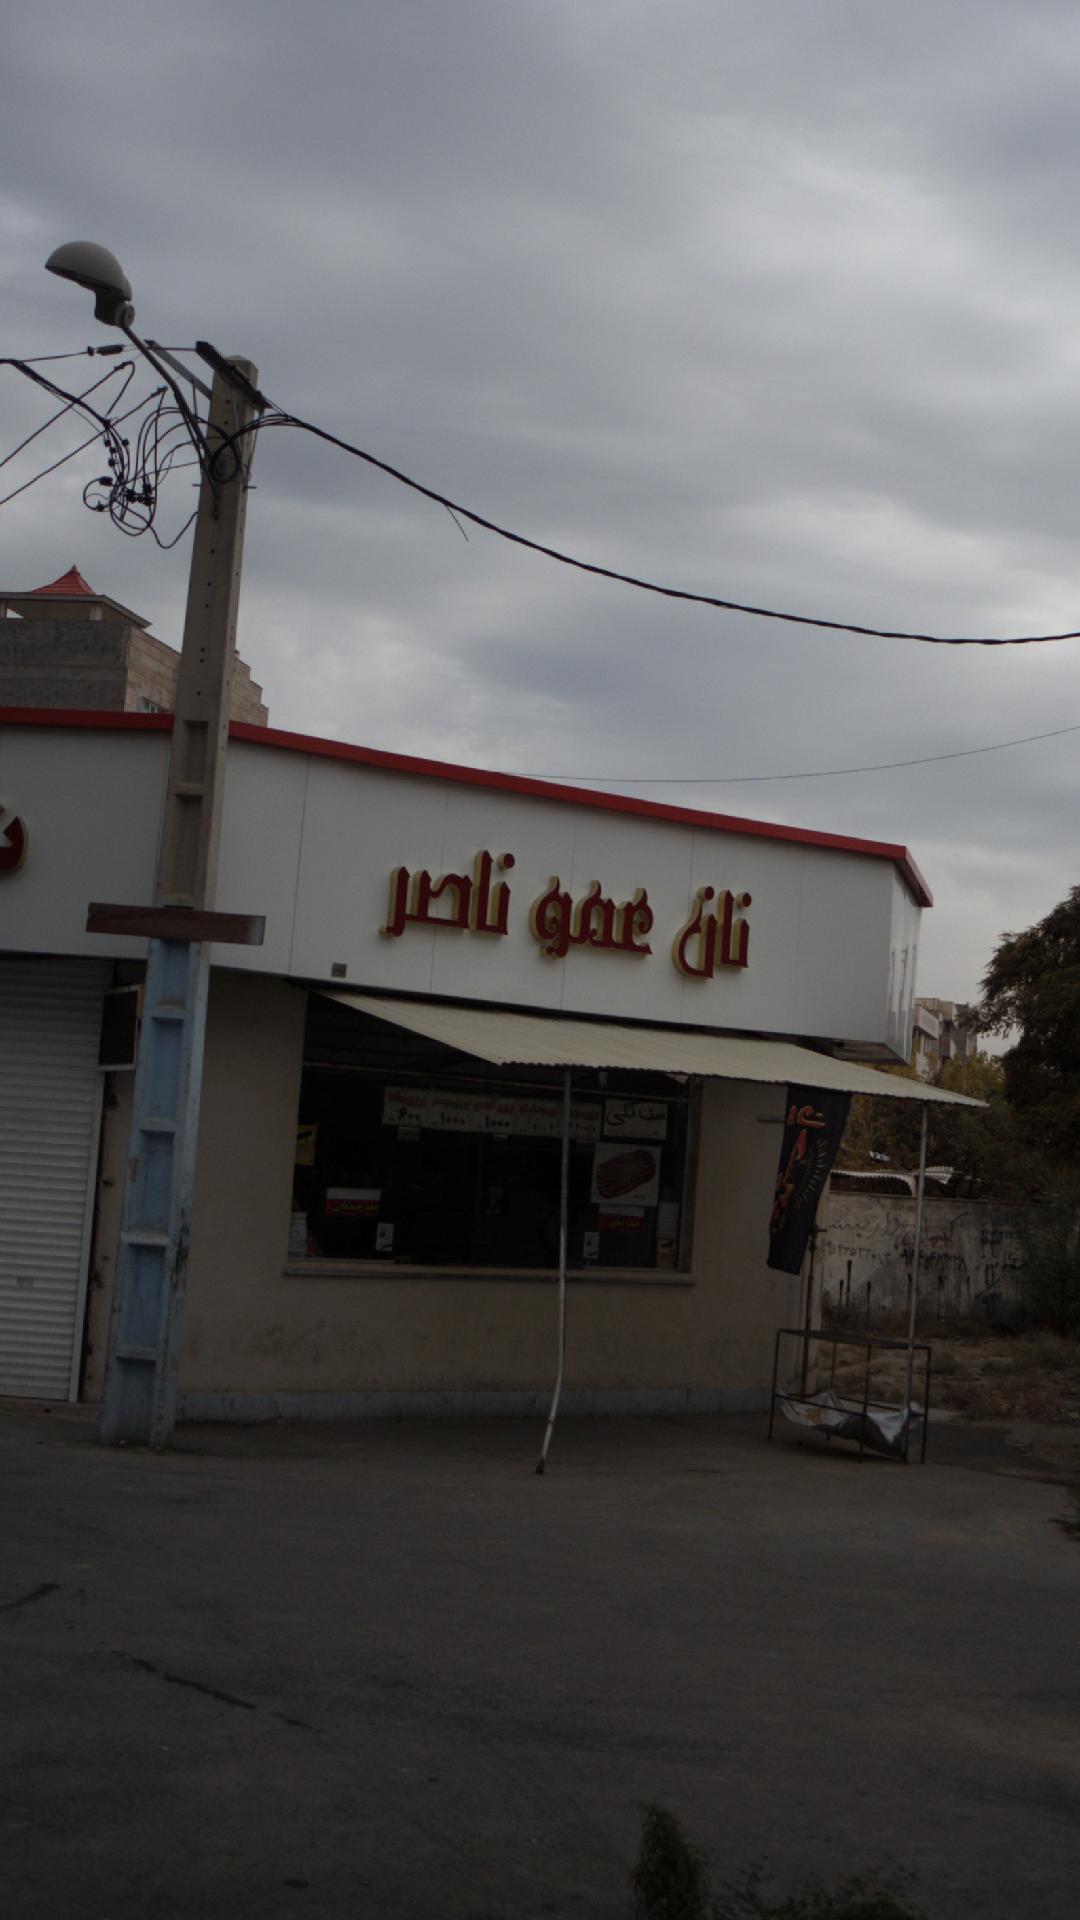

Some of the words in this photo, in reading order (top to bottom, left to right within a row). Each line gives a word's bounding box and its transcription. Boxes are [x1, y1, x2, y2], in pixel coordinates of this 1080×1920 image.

[379, 850, 516, 938] ناصر
[529, 875, 653, 958] عمو
[672, 886, 752, 979] نان
